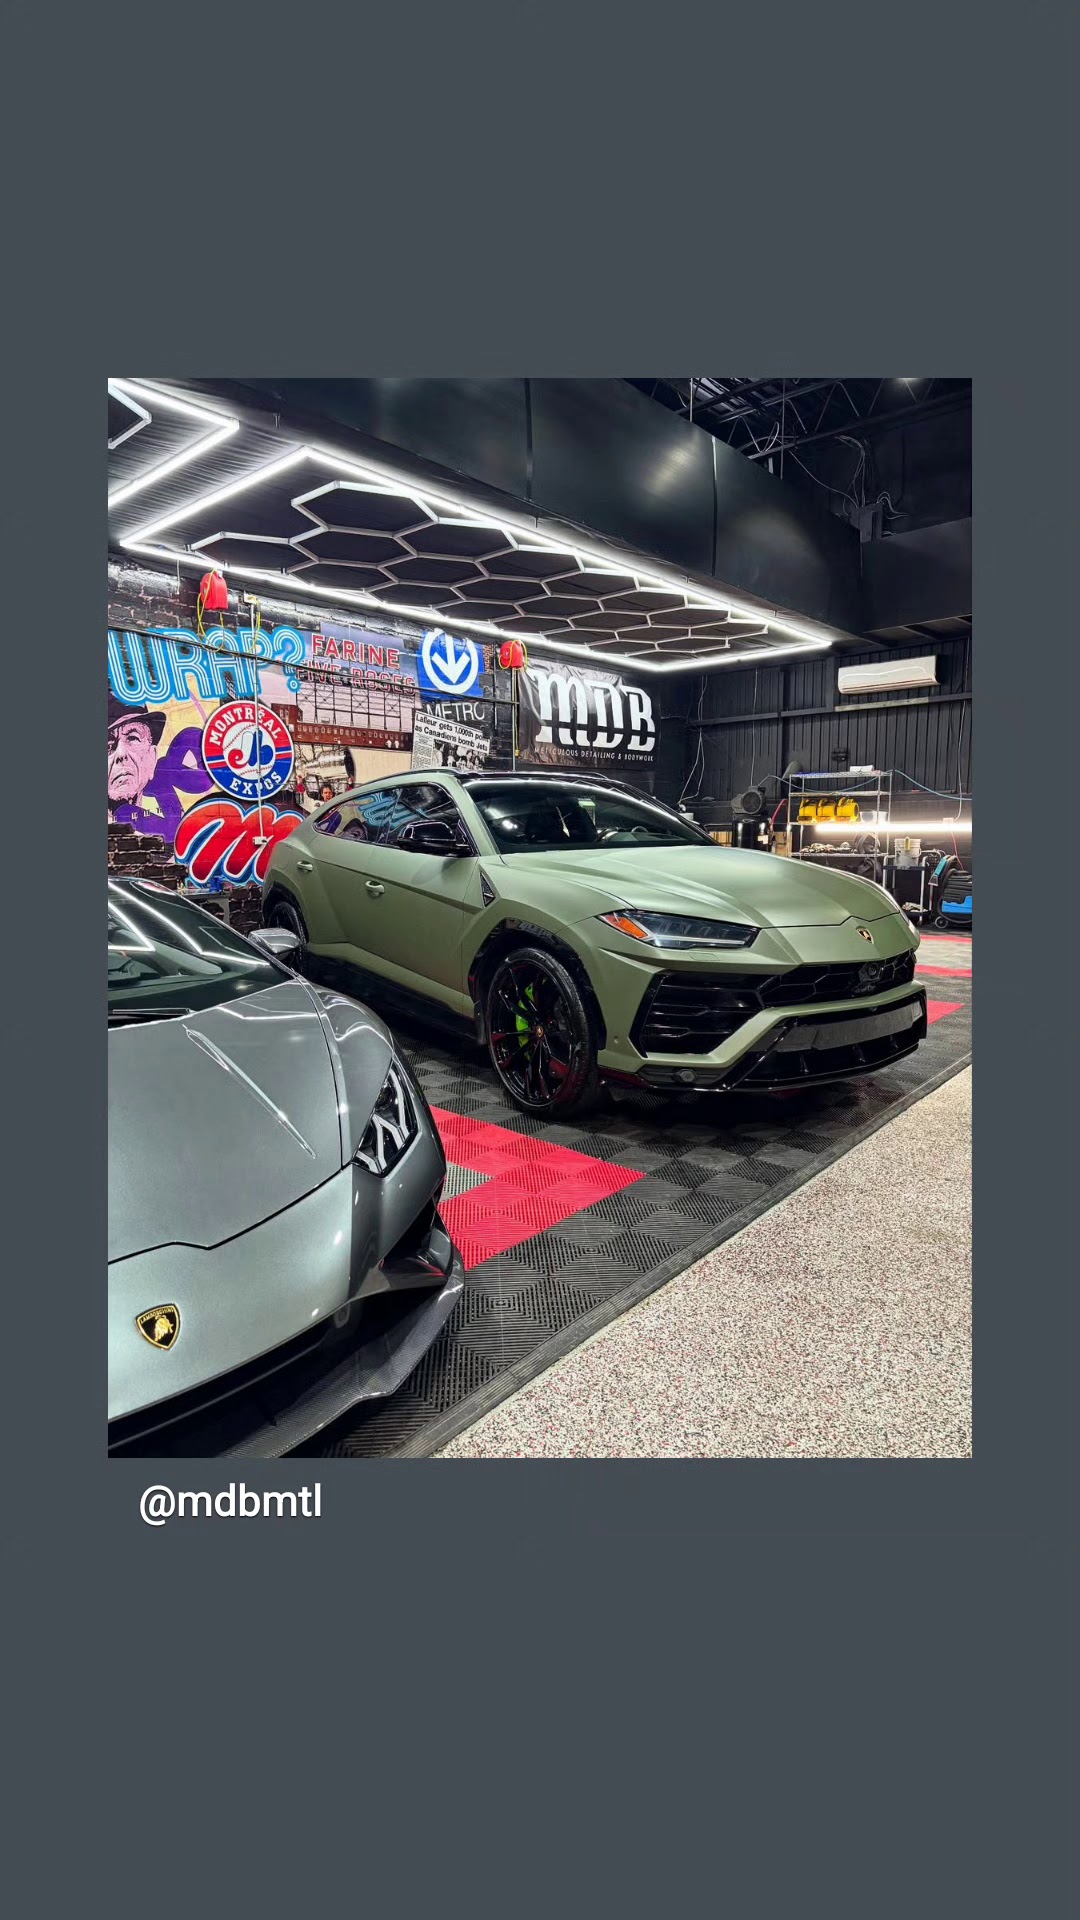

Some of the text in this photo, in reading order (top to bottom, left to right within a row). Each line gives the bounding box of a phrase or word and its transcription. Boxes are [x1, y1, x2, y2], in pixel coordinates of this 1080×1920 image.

[108, 626, 305, 704] WRAP?
[311, 633, 400, 670] FARINE
[296, 659, 416, 696] FIVE ROSES
[525, 667, 656, 752] MDB
[414, 724, 423, 733] as
[423, 726, 457, 743] Canadiens
[457, 736, 475, 748] bomb
[438, 722, 453, 732] gets
[534, 747, 579, 757] METICULOUS
[580, 750, 615, 760] DETAILING
[624, 754, 654, 762] BODYWORK
[229, 771, 282, 796] EXPOS
